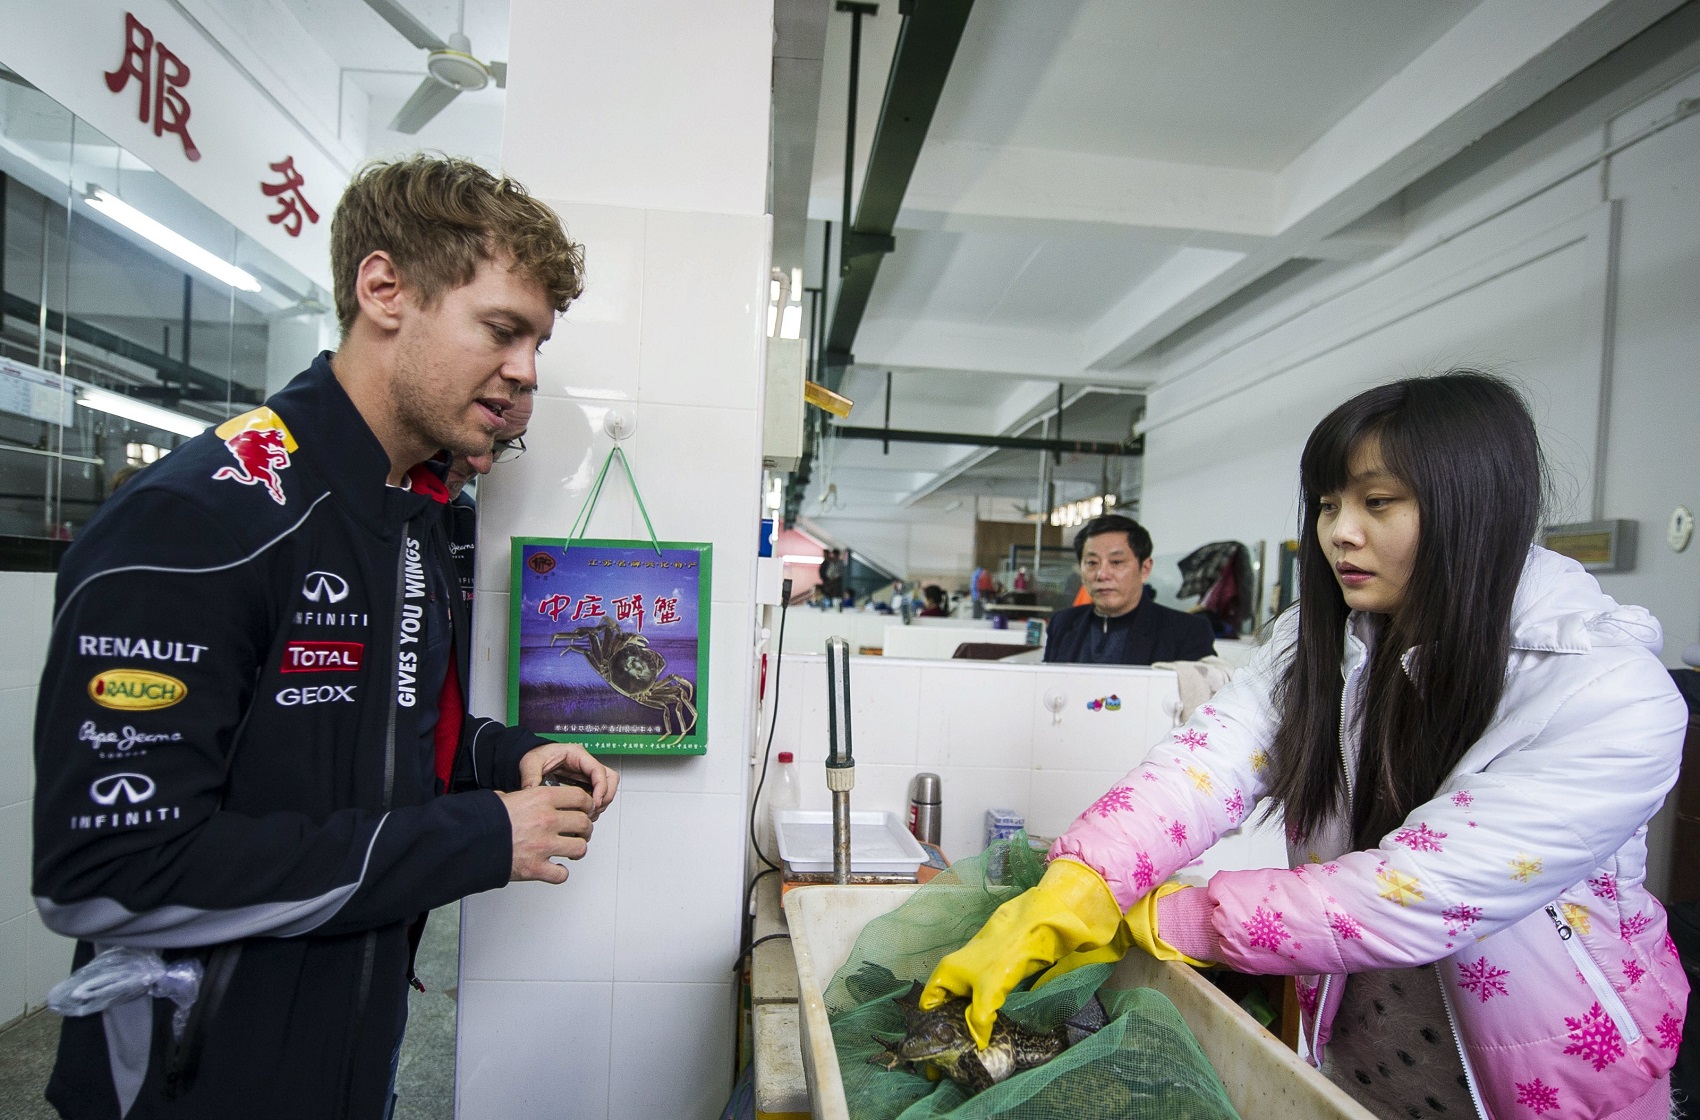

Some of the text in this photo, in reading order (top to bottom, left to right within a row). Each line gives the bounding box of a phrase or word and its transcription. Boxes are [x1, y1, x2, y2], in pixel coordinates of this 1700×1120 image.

[398, 537, 426, 708] GIVES YOU WINGS
[538, 592, 683, 634] 中庄醉蟹
[79, 635, 209, 663] RENAULT
[106, 681, 176, 700] RAUCH
[275, 685, 358, 706] GEOX
[79, 720, 184, 750] Pepe Jeans
[70, 806, 180, 829] INFINITI
